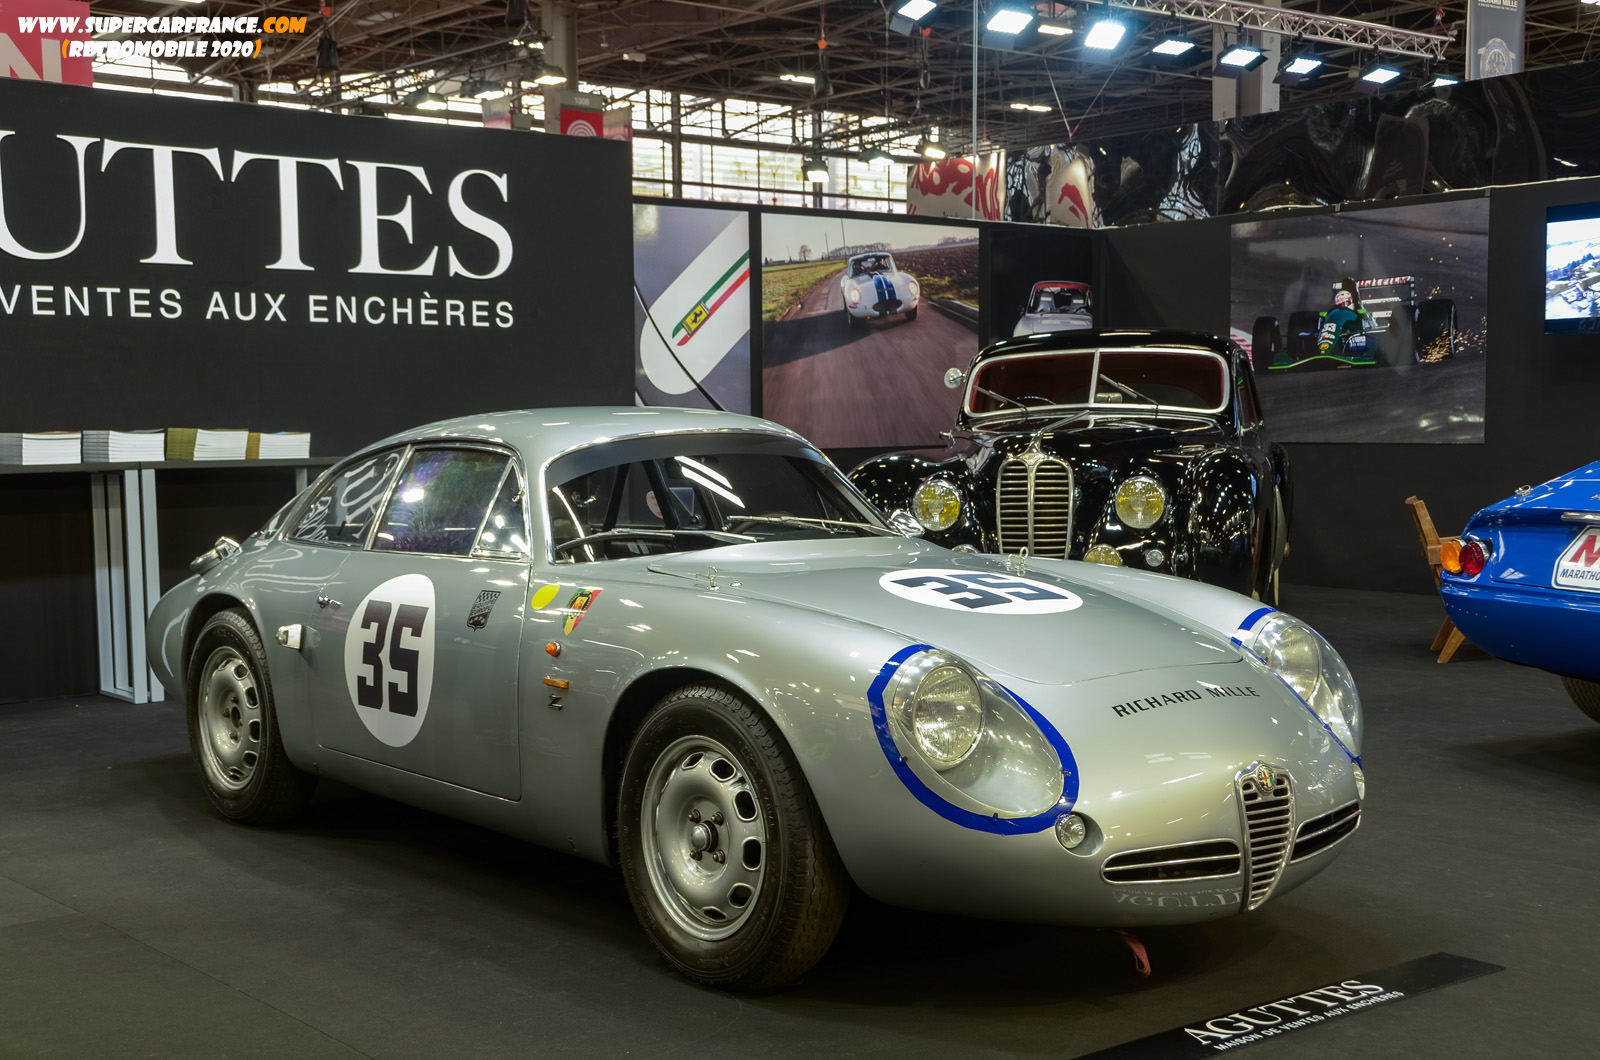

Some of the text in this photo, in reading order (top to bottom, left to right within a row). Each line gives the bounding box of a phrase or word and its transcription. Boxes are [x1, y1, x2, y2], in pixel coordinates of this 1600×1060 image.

[0, 284, 514, 329] VENTES AUX ENCHÈRES
[890, 574, 1069, 609] 35
[357, 599, 430, 718] 35
[1111, 686, 1261, 718] RICHARD MILLE
[1184, 979, 1384, 1045] AGUTTES
[1213, 1032, 1264, 1051] MAISON
[1260, 1027, 1282, 1037] DE
[1278, 1014, 1326, 1031] VENTES
[1323, 1006, 1350, 1019] AUX
